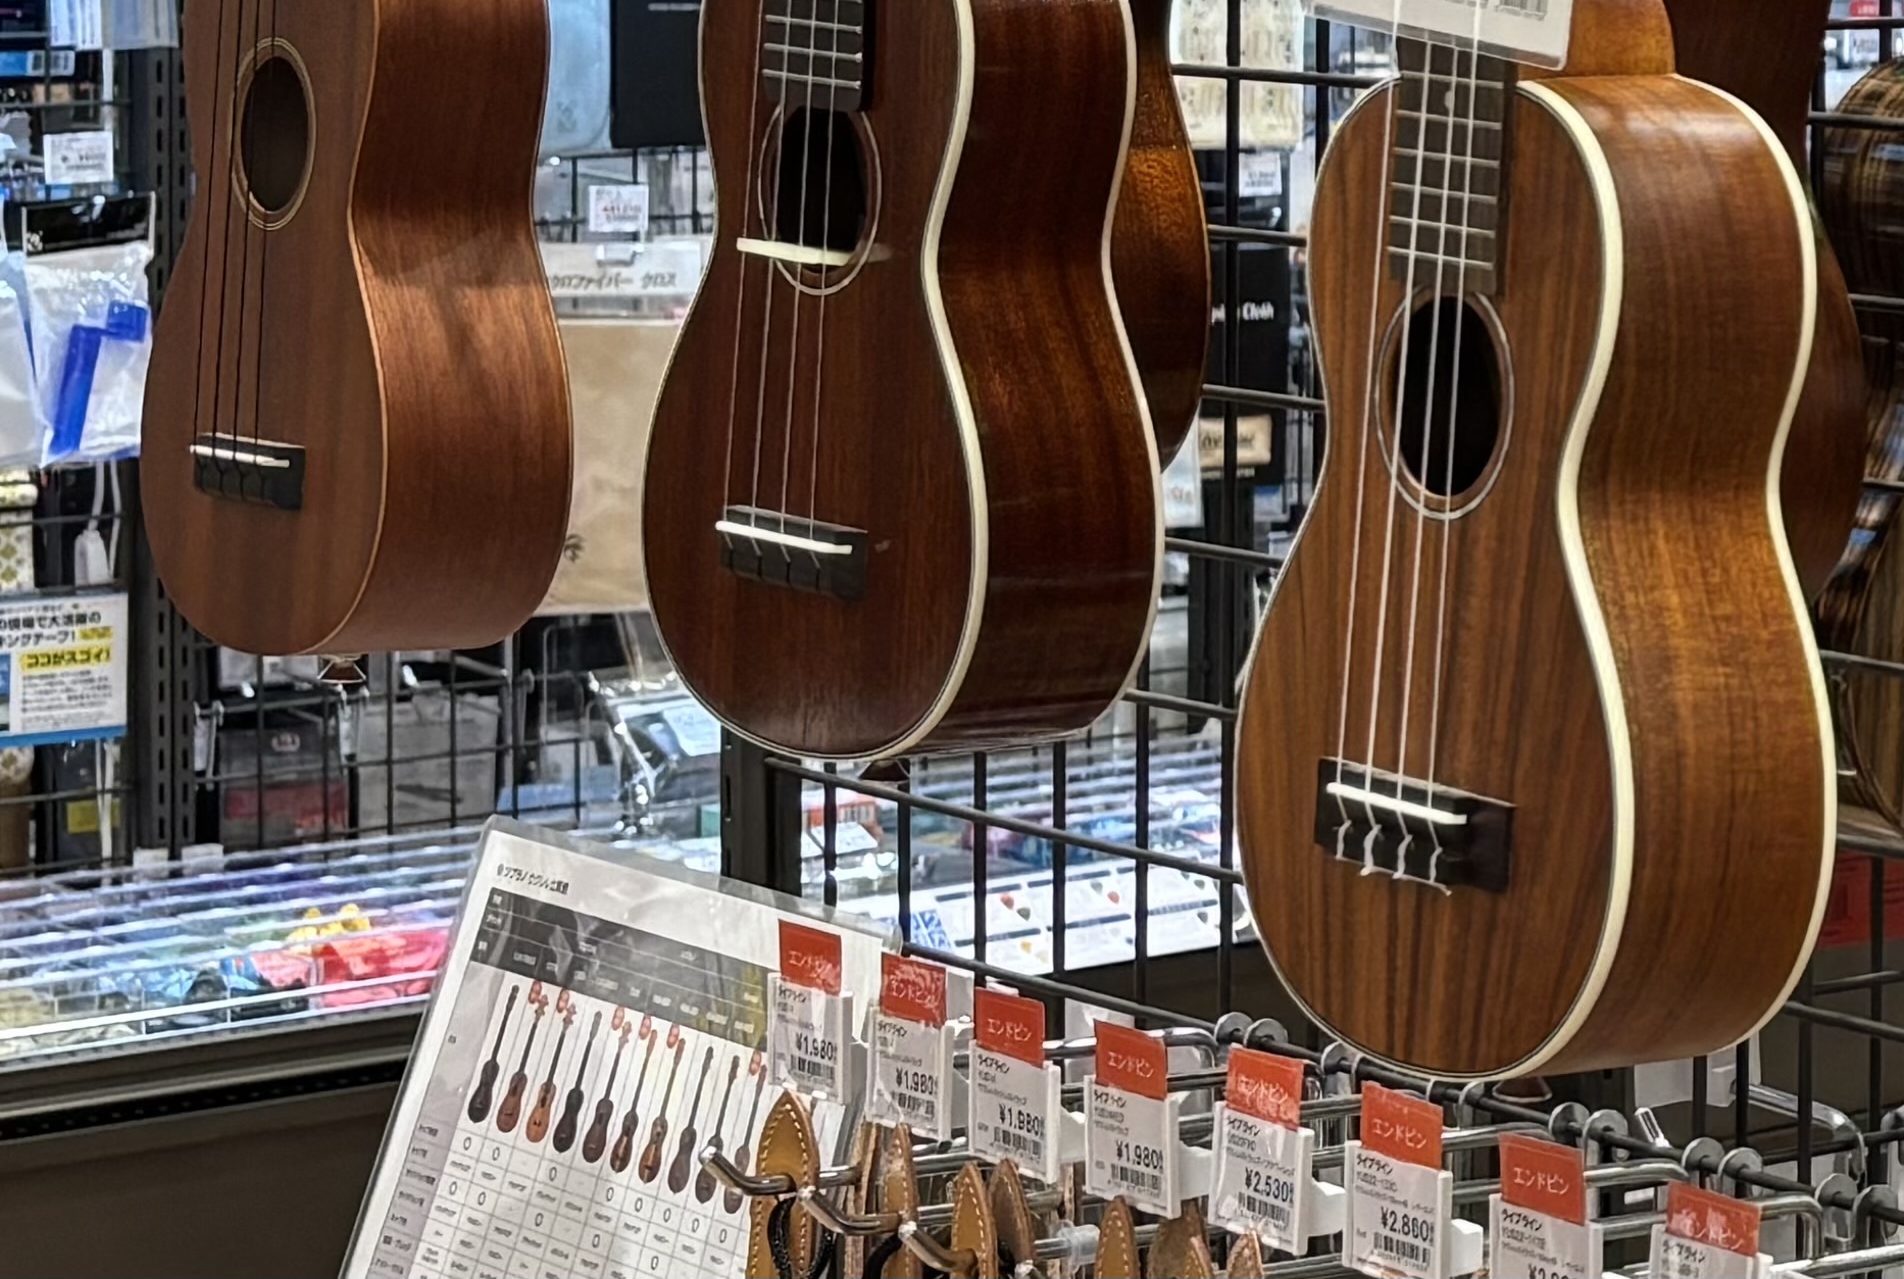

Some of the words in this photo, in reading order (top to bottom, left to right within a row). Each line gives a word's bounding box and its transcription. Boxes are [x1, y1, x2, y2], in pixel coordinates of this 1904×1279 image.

[987, 1018, 1033, 1042] エンドピン
[796, 1033, 834, 1061] ¥1,980
[1106, 1051, 1155, 1079] エンドピン
[896, 1068, 934, 1096] ¥1,980
[1238, 1076, 1290, 1105] エンドピン
[999, 1104, 1042, 1137] ¥1,980
[1371, 1118, 1428, 1150] エンドピン
[1116, 1140, 1162, 1170] ¥1,980
[1244, 1167, 1290, 1204] ¥2,530
[1513, 1166, 1571, 1195] エンドピン
